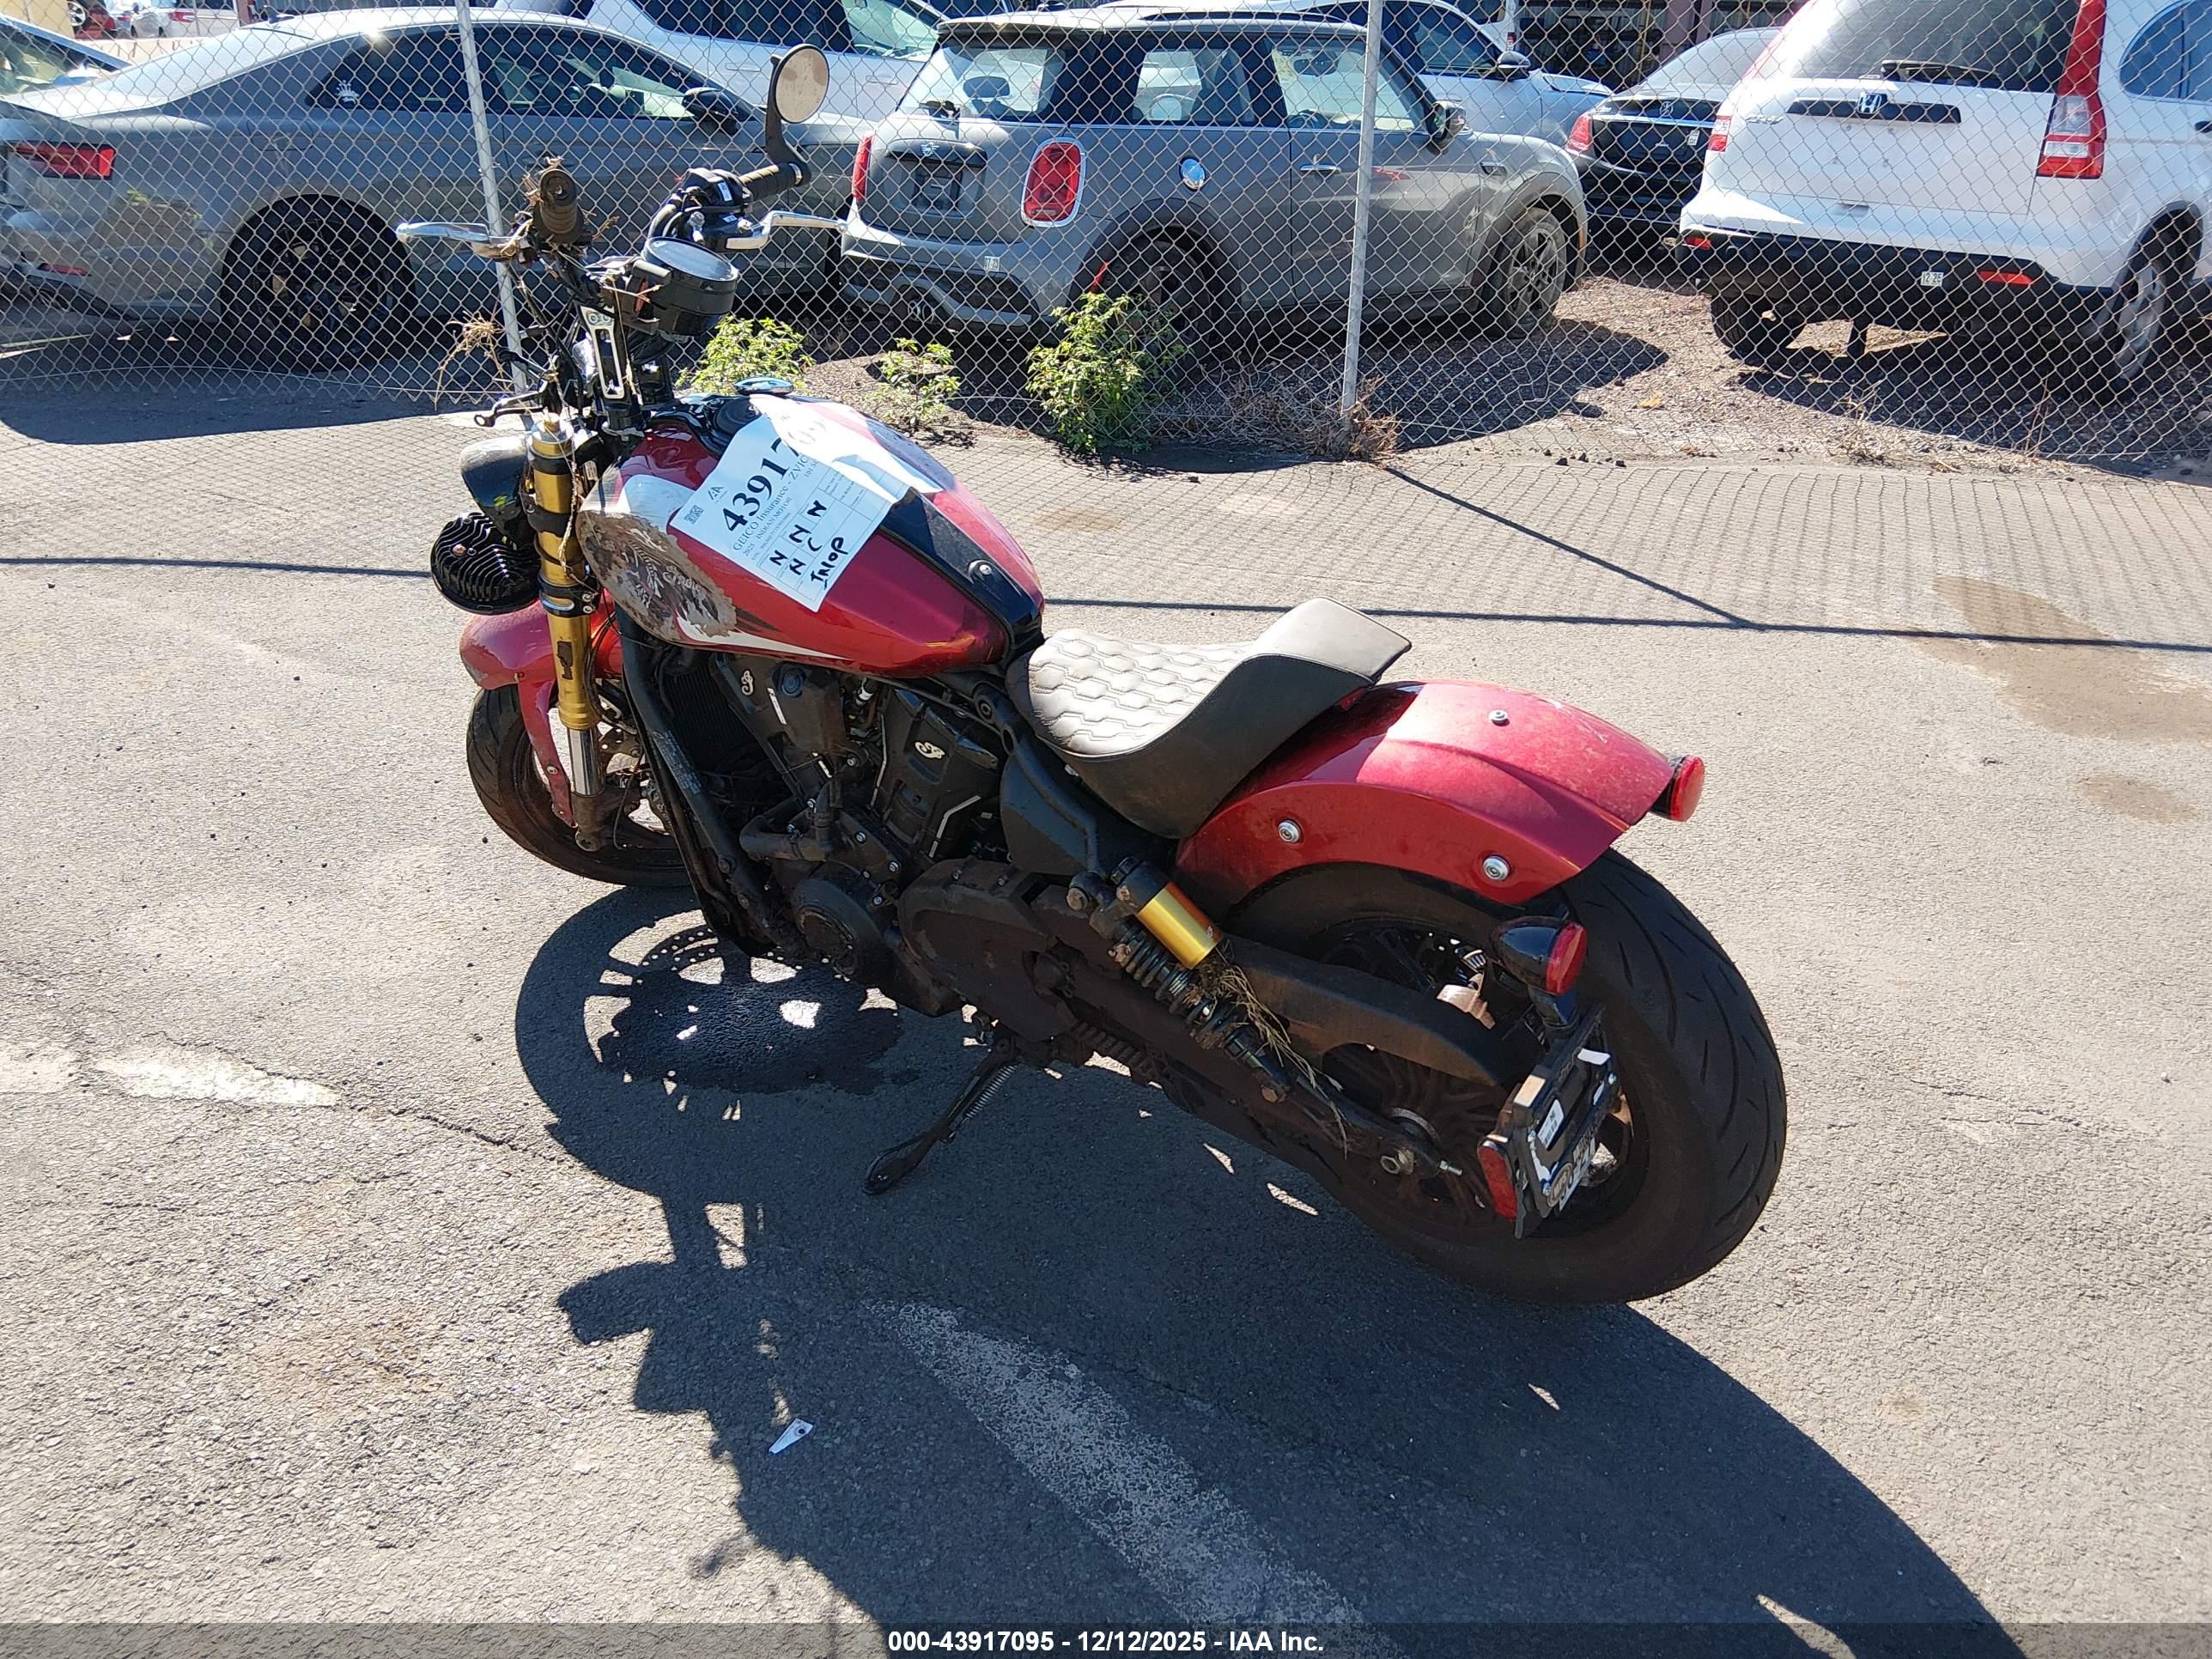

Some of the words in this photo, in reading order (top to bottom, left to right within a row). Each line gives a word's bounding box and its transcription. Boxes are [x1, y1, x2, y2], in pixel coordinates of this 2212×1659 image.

[733, 521, 758, 550] GEICO
[757, 486, 788, 522] Insurance
[743, 543, 756, 556] 2025
[756, 515, 775, 539] INDIAN
[772, 496, 793, 519] MOTOR
[769, 550, 788, 566] N
[788, 524, 811, 544] N
[806, 500, 827, 518] N
[789, 557, 806, 576] N
